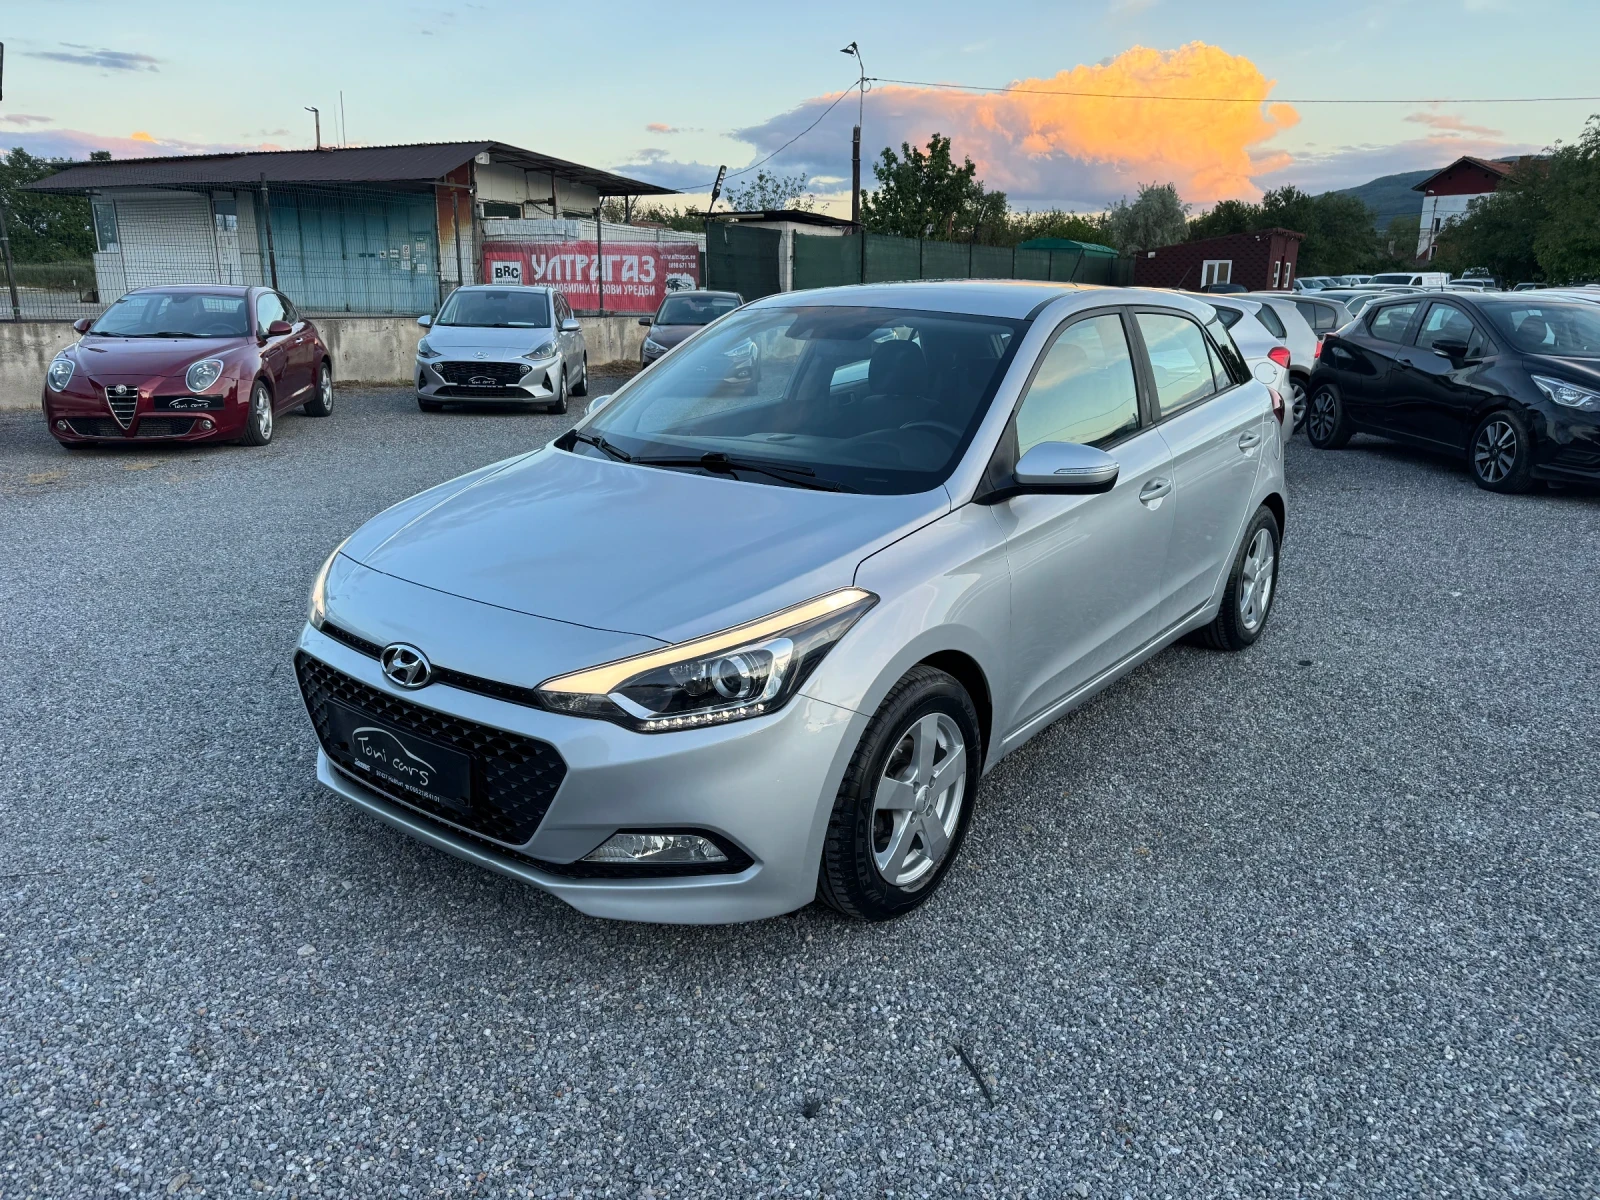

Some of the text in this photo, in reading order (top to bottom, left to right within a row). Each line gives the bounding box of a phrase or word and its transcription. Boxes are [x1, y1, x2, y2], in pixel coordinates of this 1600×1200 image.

[495, 265, 519, 279] BRC
[531, 254, 656, 283] УЛТРАГАЗ
[623, 285, 656, 297] УРЕДБИ
[357, 736, 387, 763] Toni
[392, 757, 429, 786] cars
[856, 797, 876, 891] FULDA
